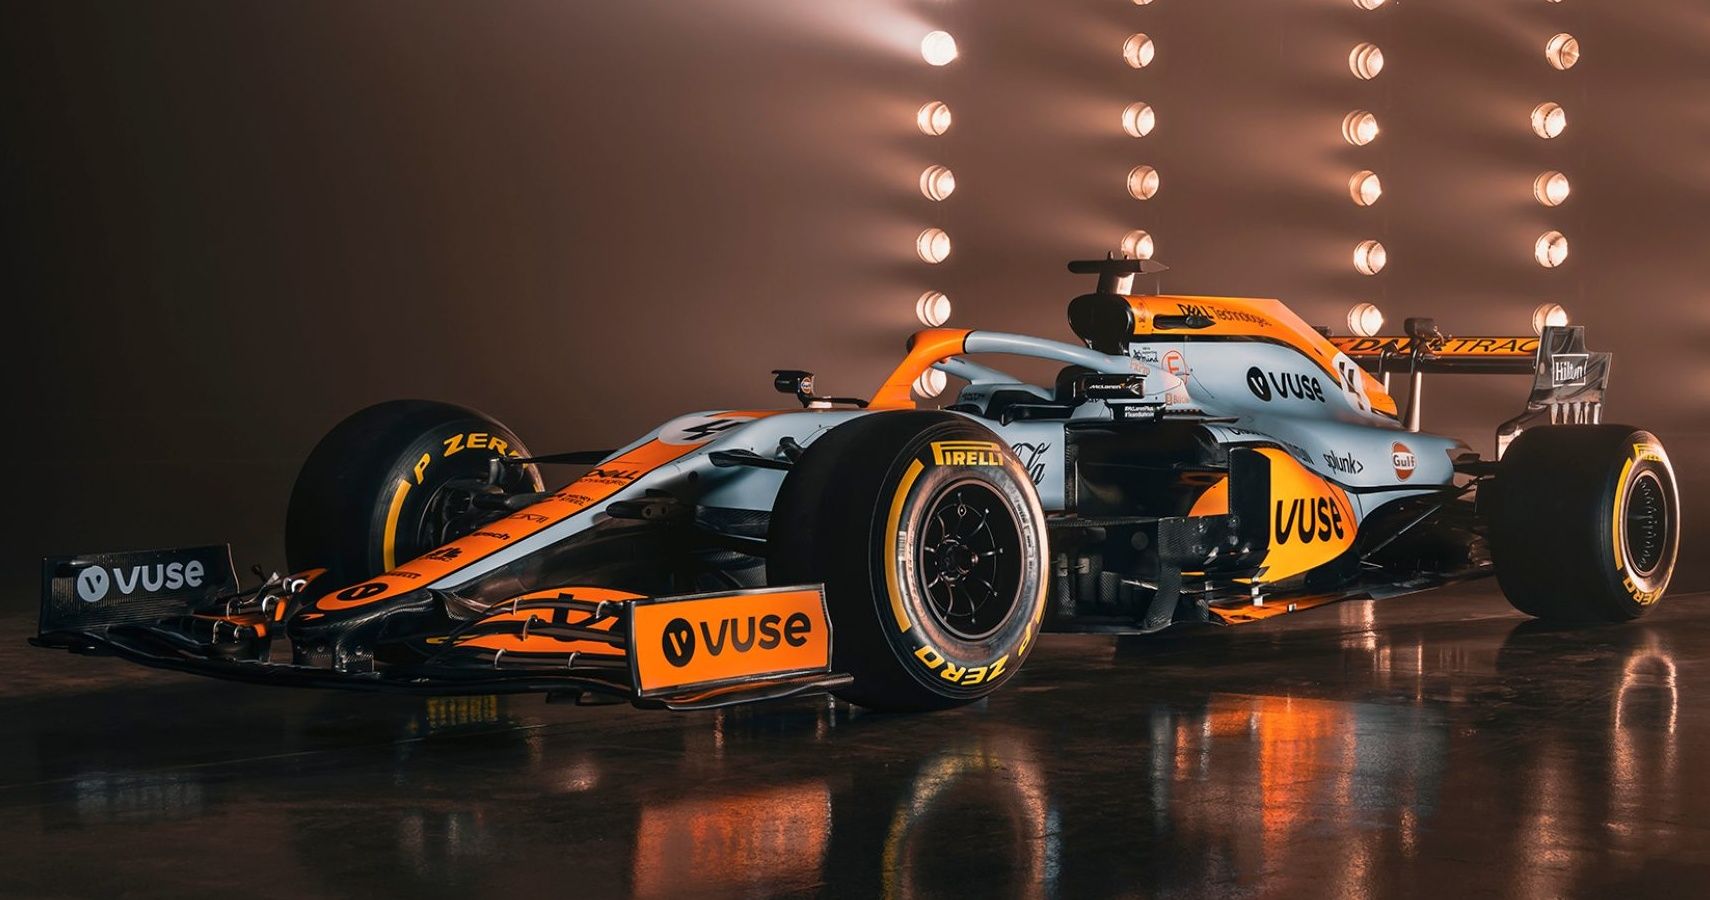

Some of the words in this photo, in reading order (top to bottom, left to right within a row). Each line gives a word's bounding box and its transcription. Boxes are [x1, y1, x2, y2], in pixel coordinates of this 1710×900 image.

[1177, 304, 1213, 319] DELL
[1555, 361, 1583, 381] Hilton
[931, 440, 1004, 466] PIRELLI
[1393, 454, 1415, 467] Gulf
[413, 453, 431, 485] P
[1622, 576, 1663, 606] ZERO
[914, 644, 1009, 686] ZERO
